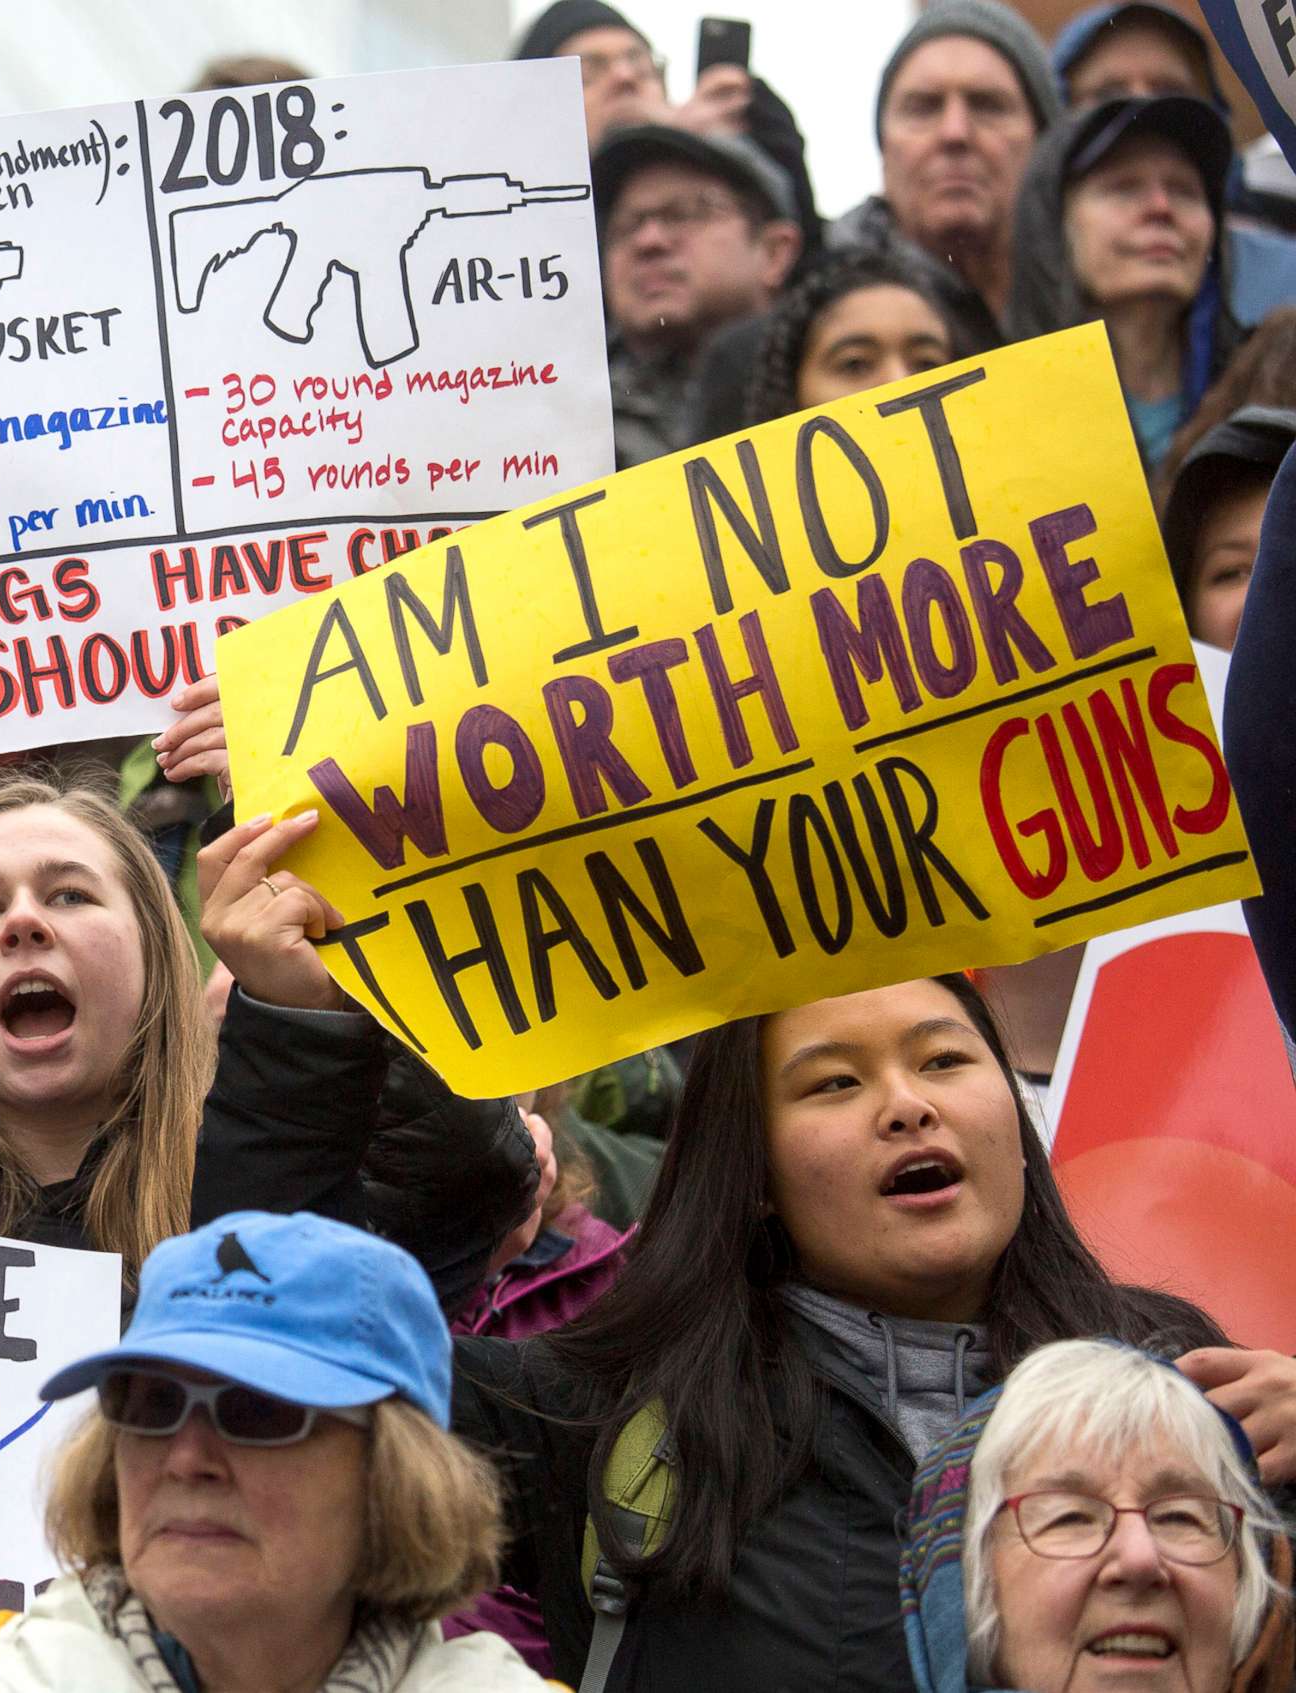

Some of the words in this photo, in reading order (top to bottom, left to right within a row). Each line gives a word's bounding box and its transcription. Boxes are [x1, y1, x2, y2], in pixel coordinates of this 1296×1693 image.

[159, 86, 348, 194] 2018:
[432, 254, 569, 305] AR-15
[294, 368, 394, 401] round
[406, 360, 559, 405] magazine
[221, 407, 363, 448] capacity
[308, 453, 410, 491] rounds
[427, 456, 480, 491] per
[504, 451, 559, 480] min
[9, 506, 60, 552] per
[76, 491, 156, 528] min.
[150, 530, 333, 611] HAVE
[281, 544, 489, 756] AM
[521, 489, 639, 663] I
[683, 367, 987, 615] NOT
[307, 611, 800, 870] WORTH
[809, 502, 1134, 731] MORE
[314, 836, 704, 1054] THAN
[697, 756, 991, 958] YOUR
[980, 664, 1232, 900] GUNS
